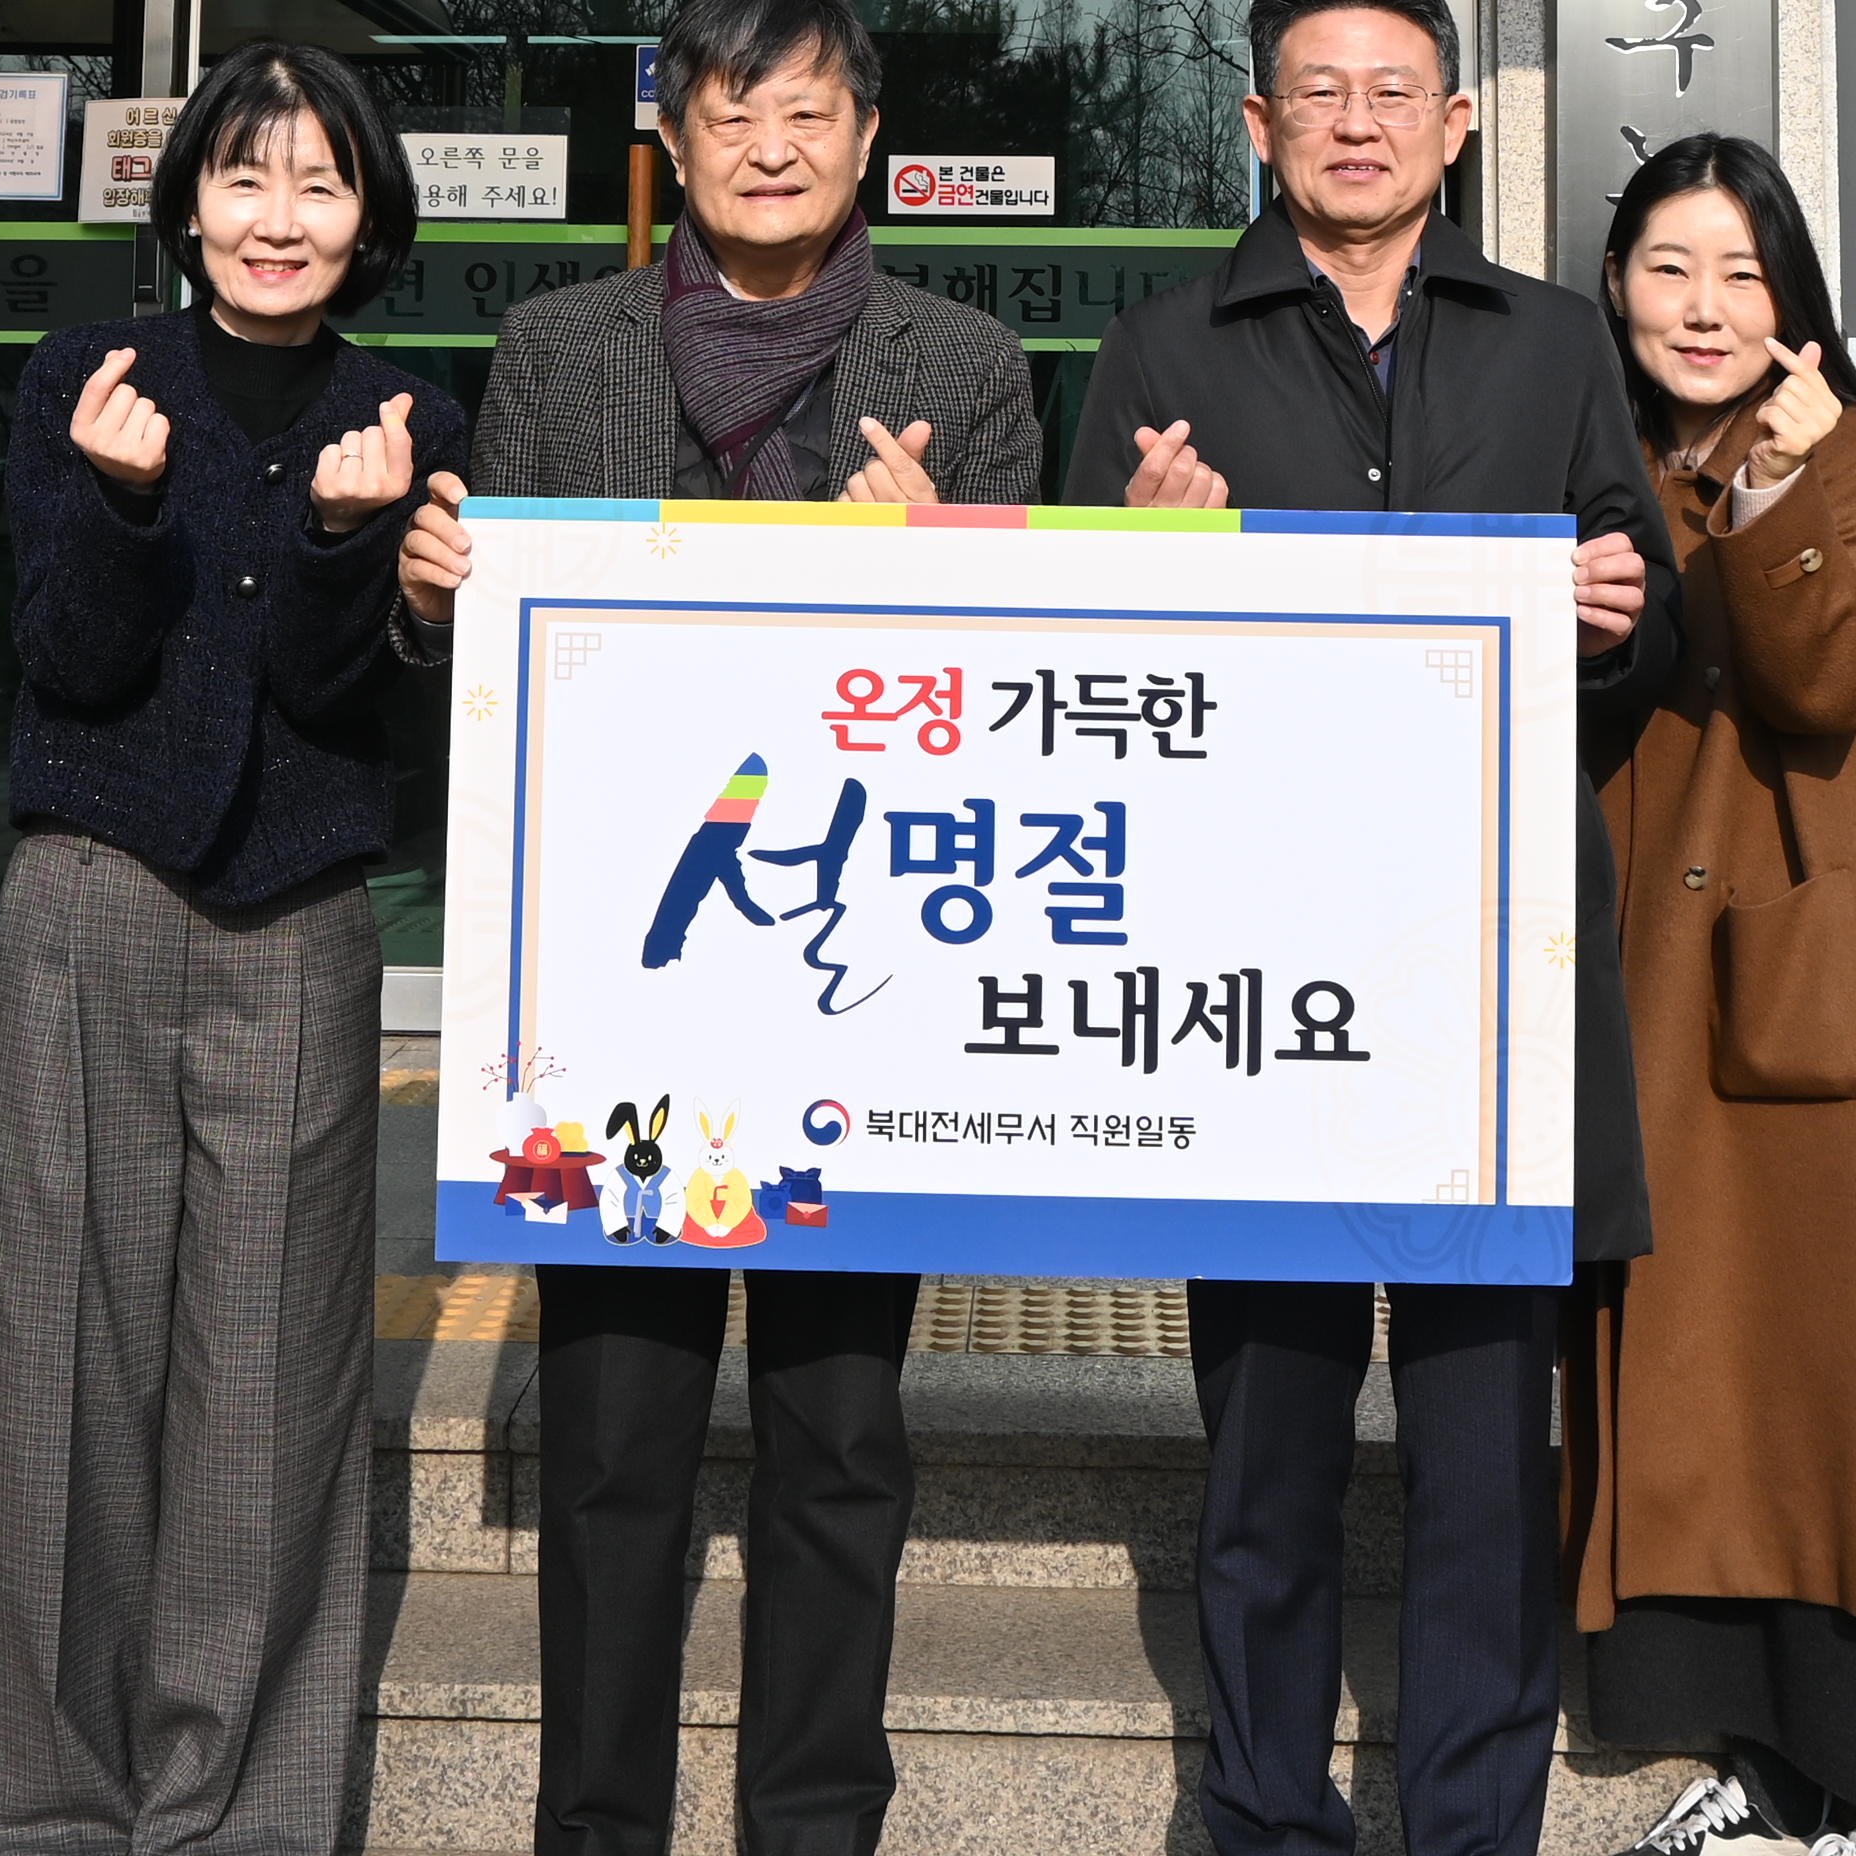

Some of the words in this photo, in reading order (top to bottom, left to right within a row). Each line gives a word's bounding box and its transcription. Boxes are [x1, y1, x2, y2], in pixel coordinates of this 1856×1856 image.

[107, 129, 162, 149] 회원증을
[416, 147, 485, 170] 오른쪽
[498, 147, 544, 170] 문을
[939, 166, 954, 182] 본
[959, 165, 1006, 182] 건물은
[481, 185, 557, 209] 주세요!
[820, 666, 964, 757] 온정
[987, 669, 1218, 761] 가득한
[640, 751, 894, 1017] 설
[882, 798, 1129, 947] 명절
[963, 965, 1372, 1078] 보내세요
[865, 1108, 1056, 1148] 북대전세무서
[1069, 1113, 1197, 1151] 직원일동
